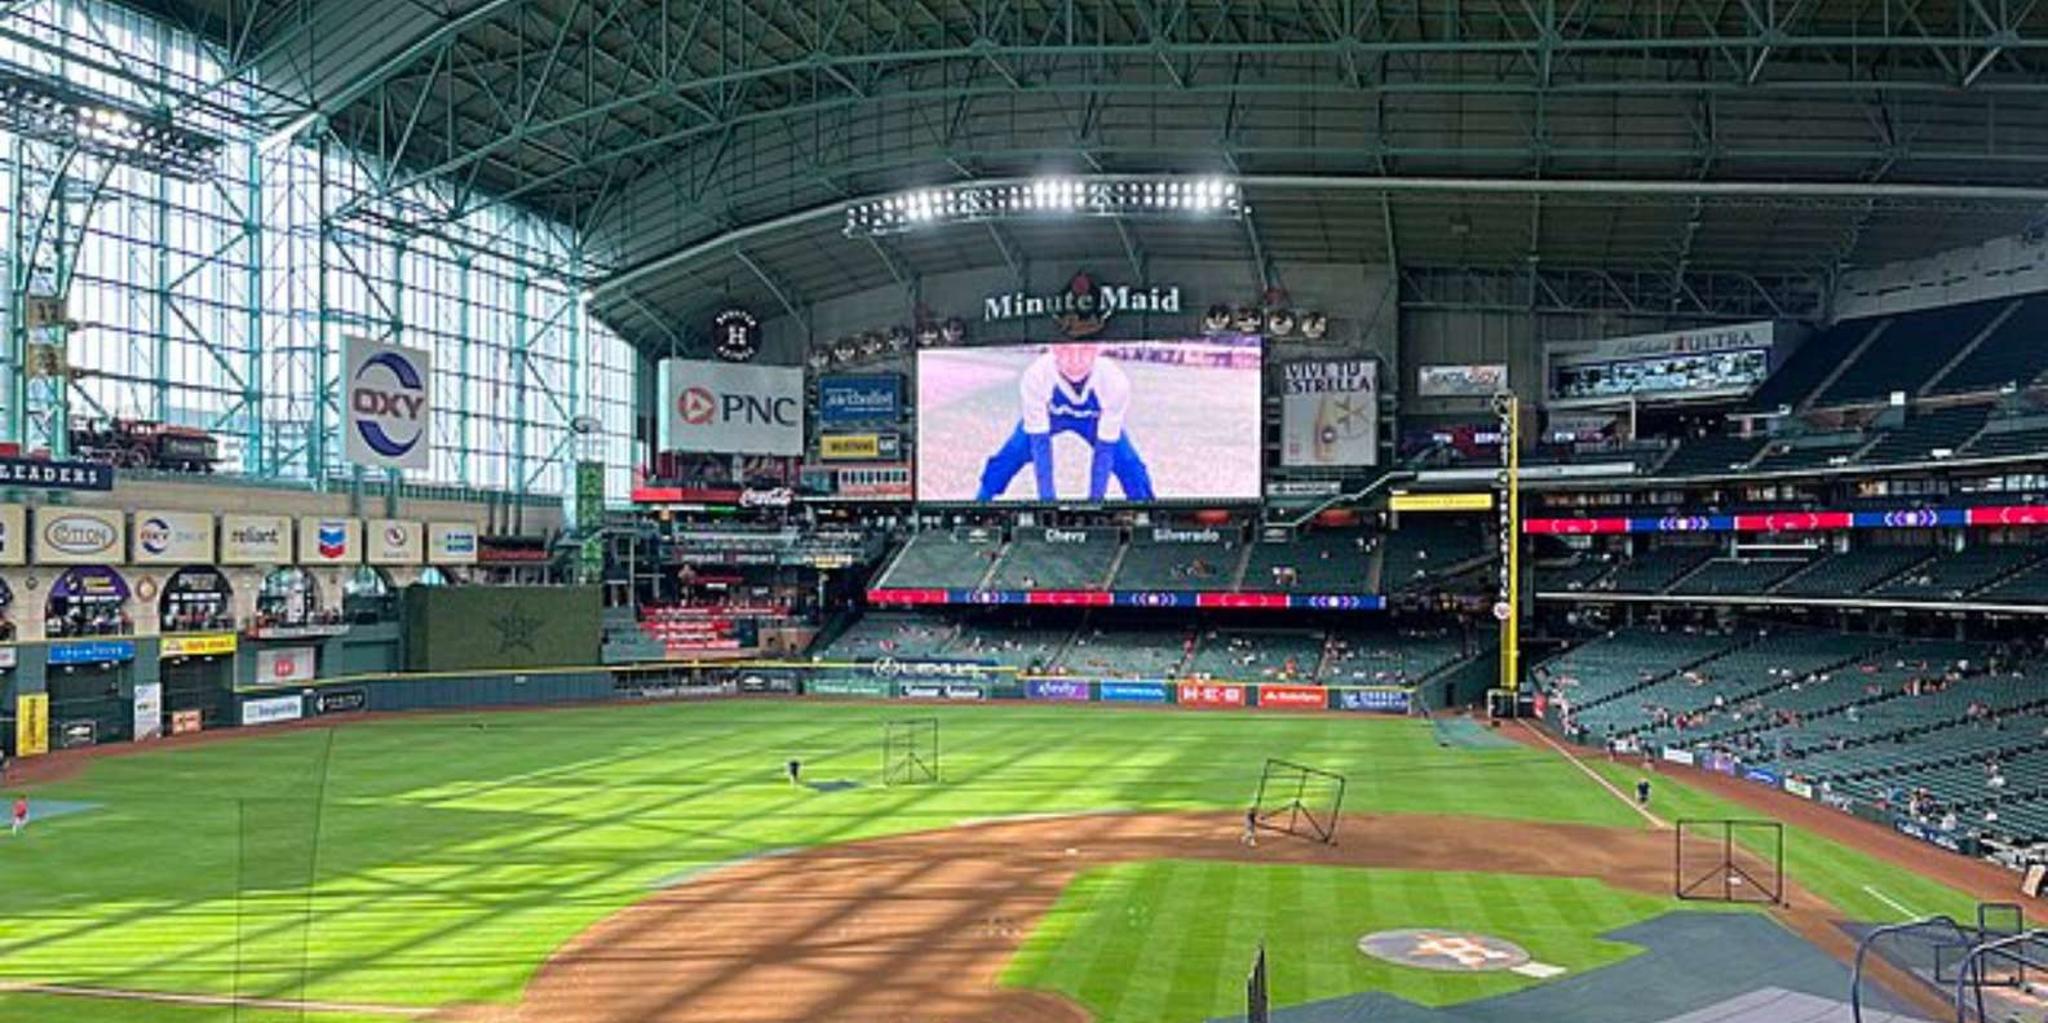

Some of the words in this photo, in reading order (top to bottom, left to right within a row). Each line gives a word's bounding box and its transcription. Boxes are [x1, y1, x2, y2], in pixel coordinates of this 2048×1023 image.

[984, 291, 1093, 322] Minute
[1100, 286, 1180, 313] Maid
[729, 326, 746, 344] H
[1284, 376, 1375, 394] ESTRELLA
[354, 387, 424, 419] OXY
[721, 393, 797, 426] PNC
[0, 464, 98, 485] LEADERS
[1045, 528, 1087, 543] Chevy
